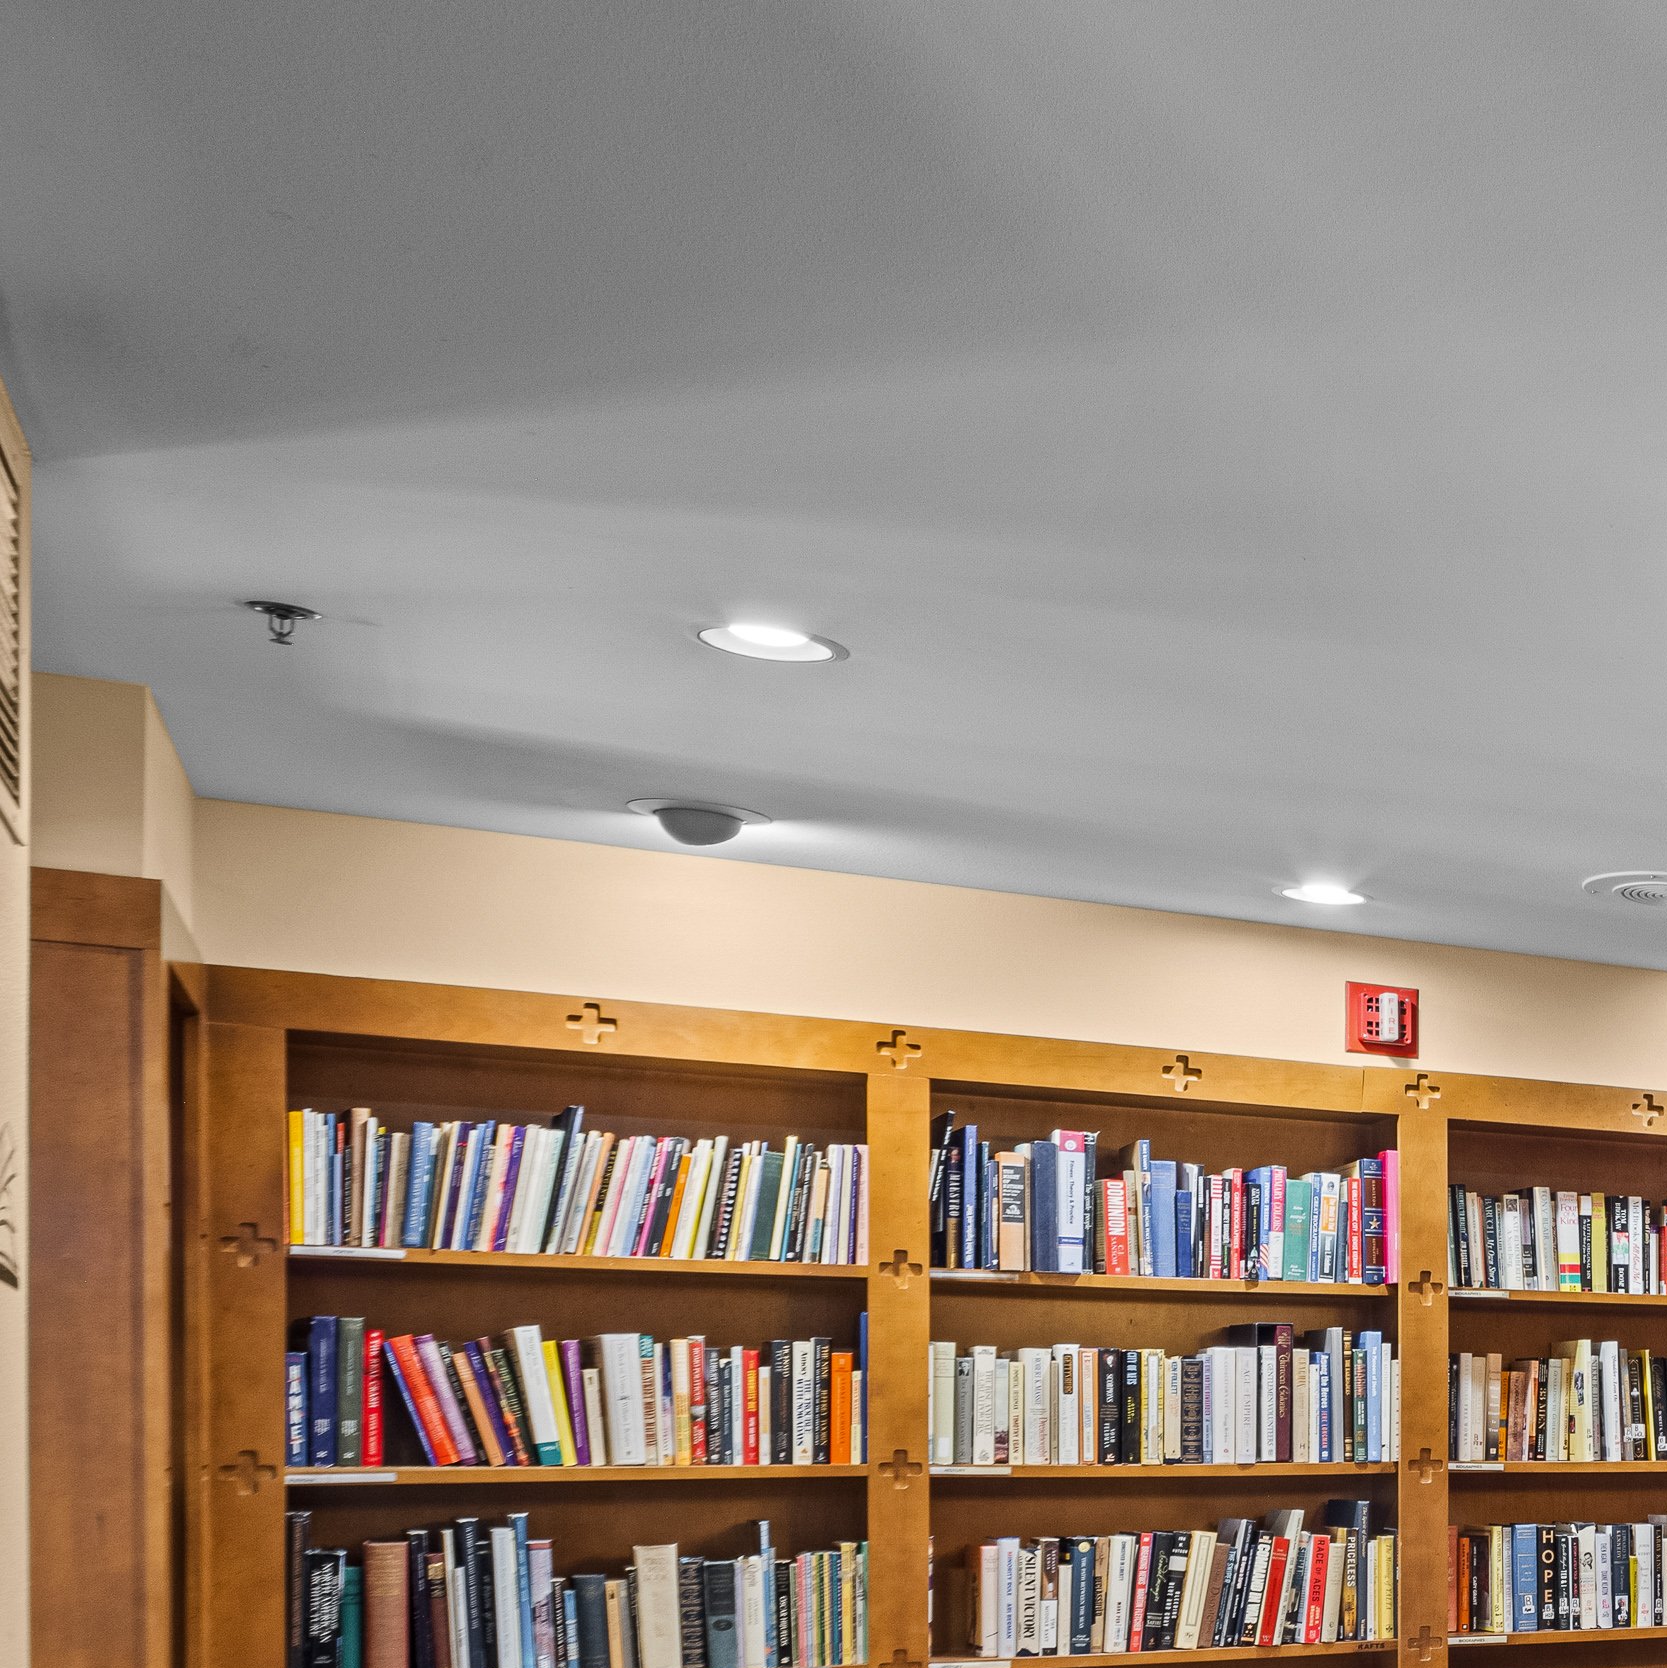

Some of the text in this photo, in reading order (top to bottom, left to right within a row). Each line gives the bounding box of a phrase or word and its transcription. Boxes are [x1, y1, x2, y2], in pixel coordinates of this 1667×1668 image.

[1388, 998, 1396, 1034] FIRE
[1106, 1180, 1125, 1236] DOMINION
[1246, 1544, 1270, 1624] COMMAND IN WAR
[1312, 1540, 1324, 1602] RACE OF ACES
[1347, 1536, 1356, 1587] PRICELESS
[1540, 1530, 1555, 1604] HOPE
[1023, 1556, 1036, 1640] SILENT VICTORY
